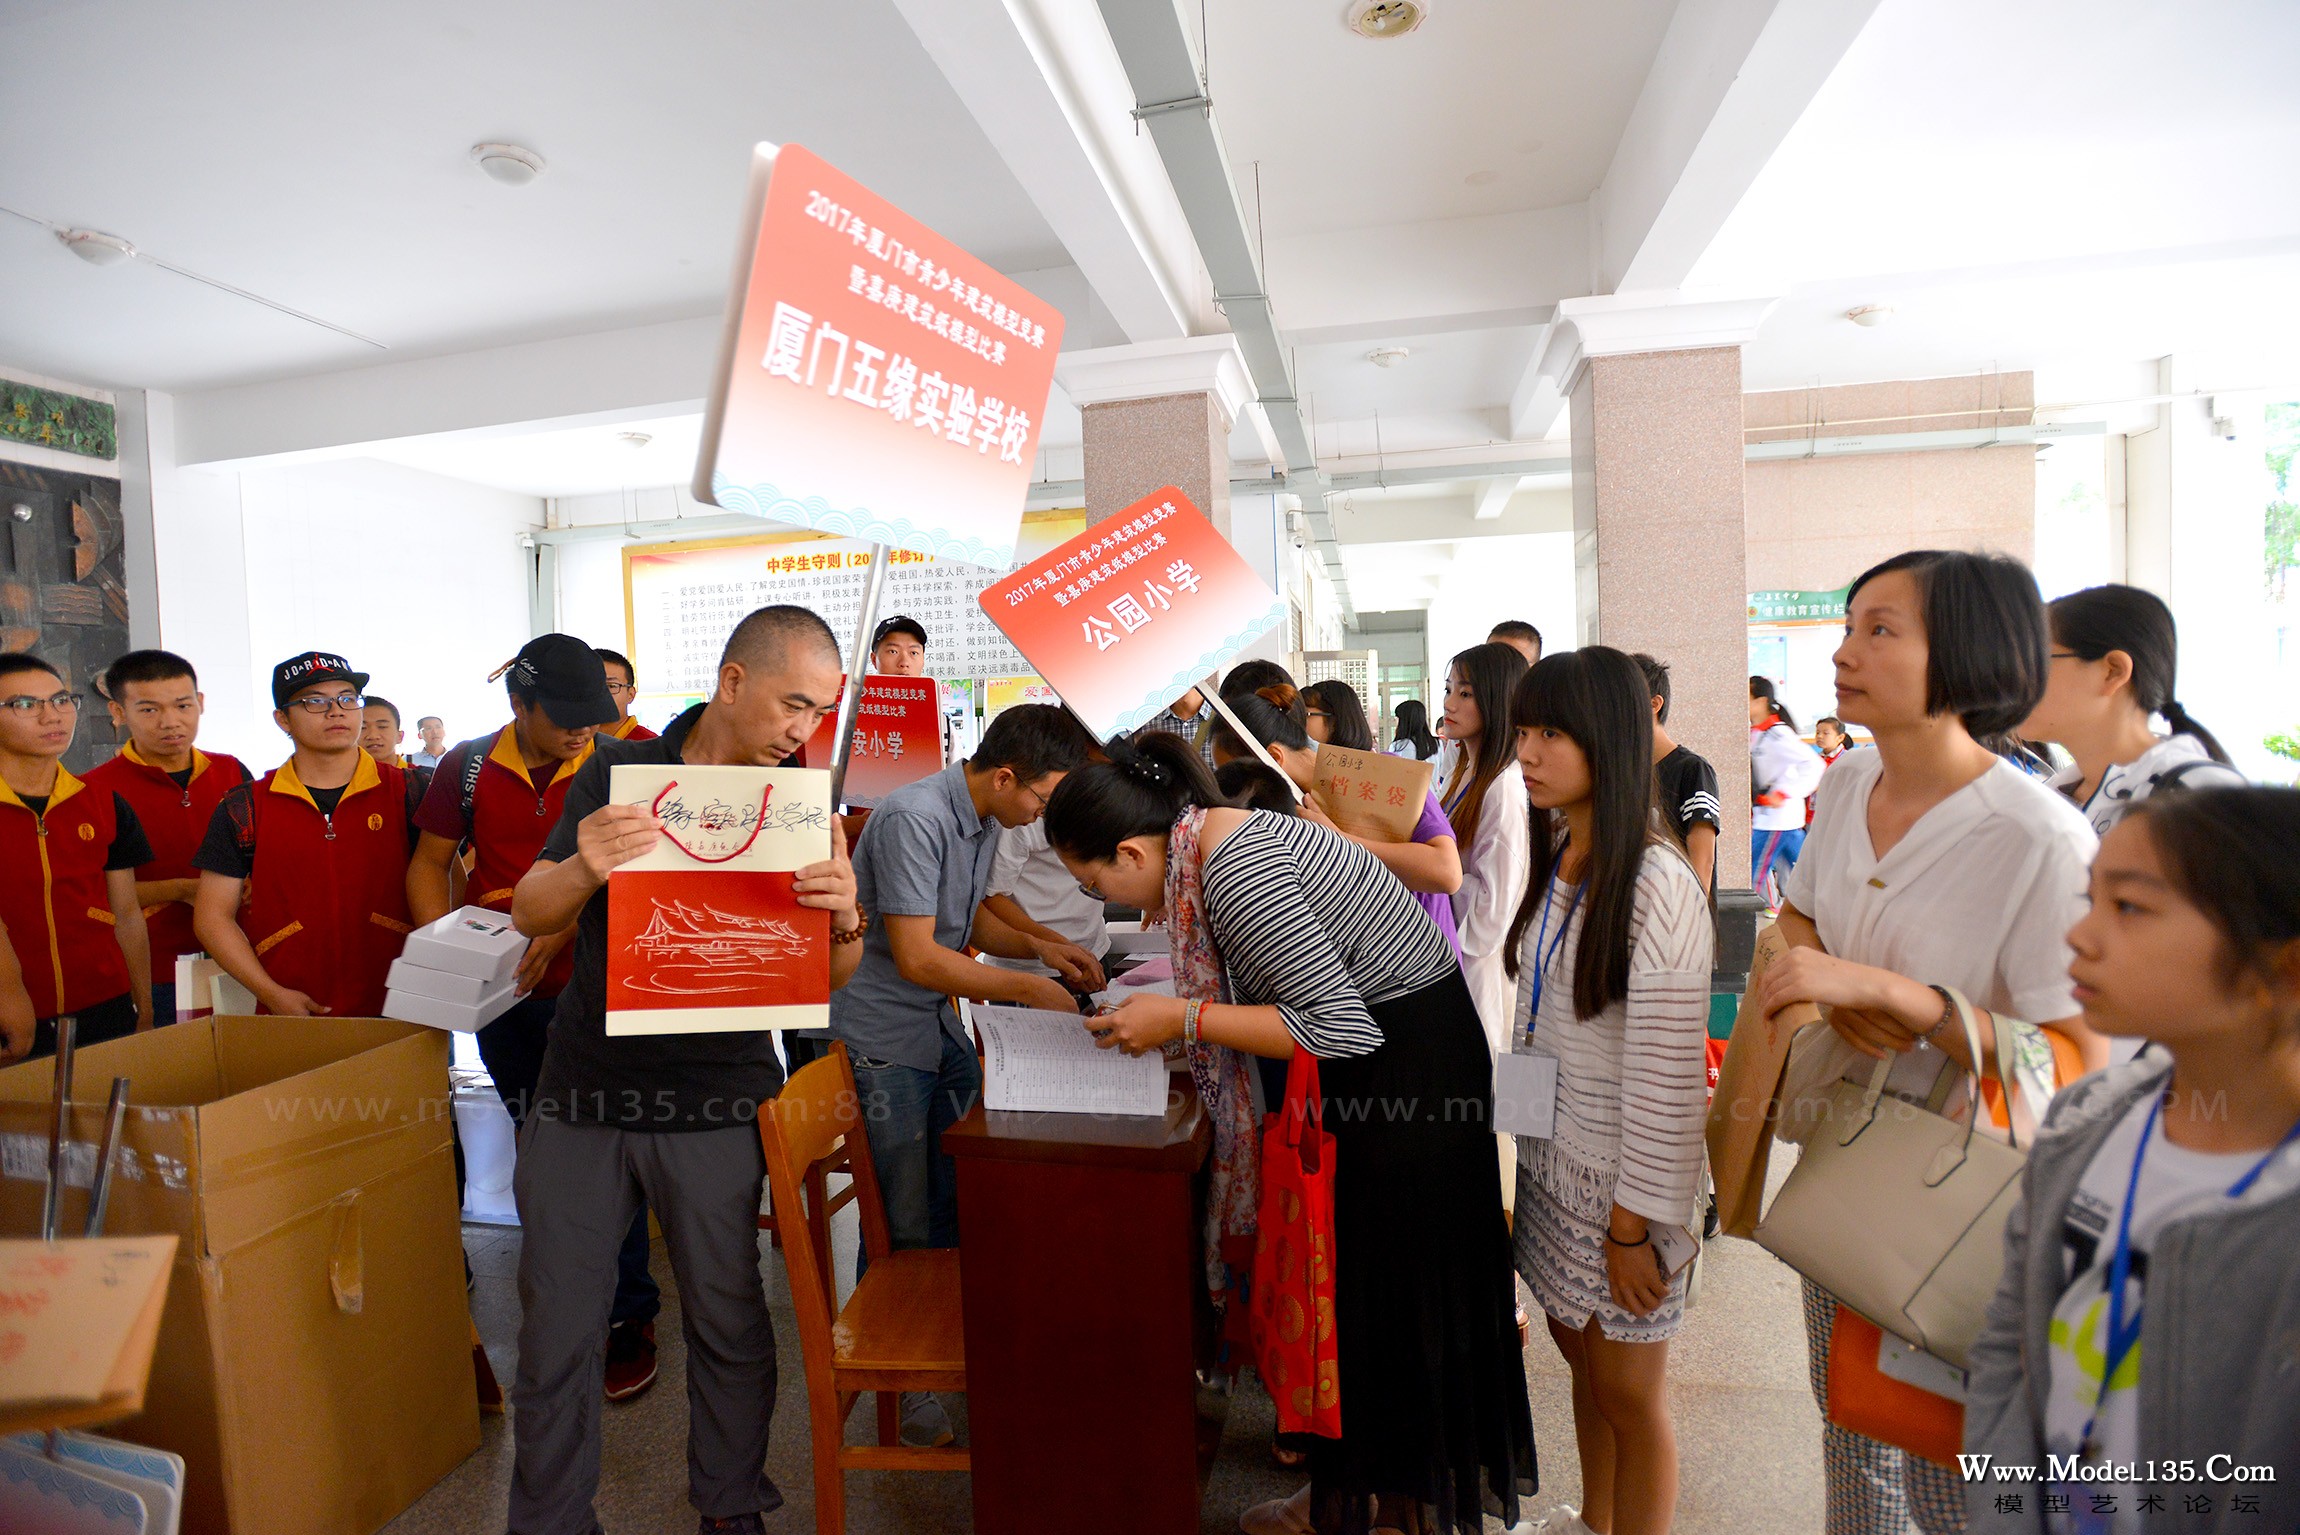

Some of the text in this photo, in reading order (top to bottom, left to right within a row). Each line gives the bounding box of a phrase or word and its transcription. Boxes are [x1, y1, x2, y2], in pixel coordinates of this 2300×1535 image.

[804, 189, 1046, 349] 2017年厦门市青少年建筑模型竞赛
[847, 264, 1007, 366] 暨嘉庚建筑纸模型比赛
[761, 301, 1031, 466] 厦门五缘实验学校
[1004, 501, 1178, 607] 2017年厦门市青少年建筑模型竞赛
[1053, 531, 1168, 608] 暨嘉庚建筑纸模型比赛
[1080, 558, 1203, 652] 公园小学
[853, 728, 904, 761] 安小学
[1329, 774, 1407, 807] 档案袋
[629, 798, 831, 833] 缘实验学校
